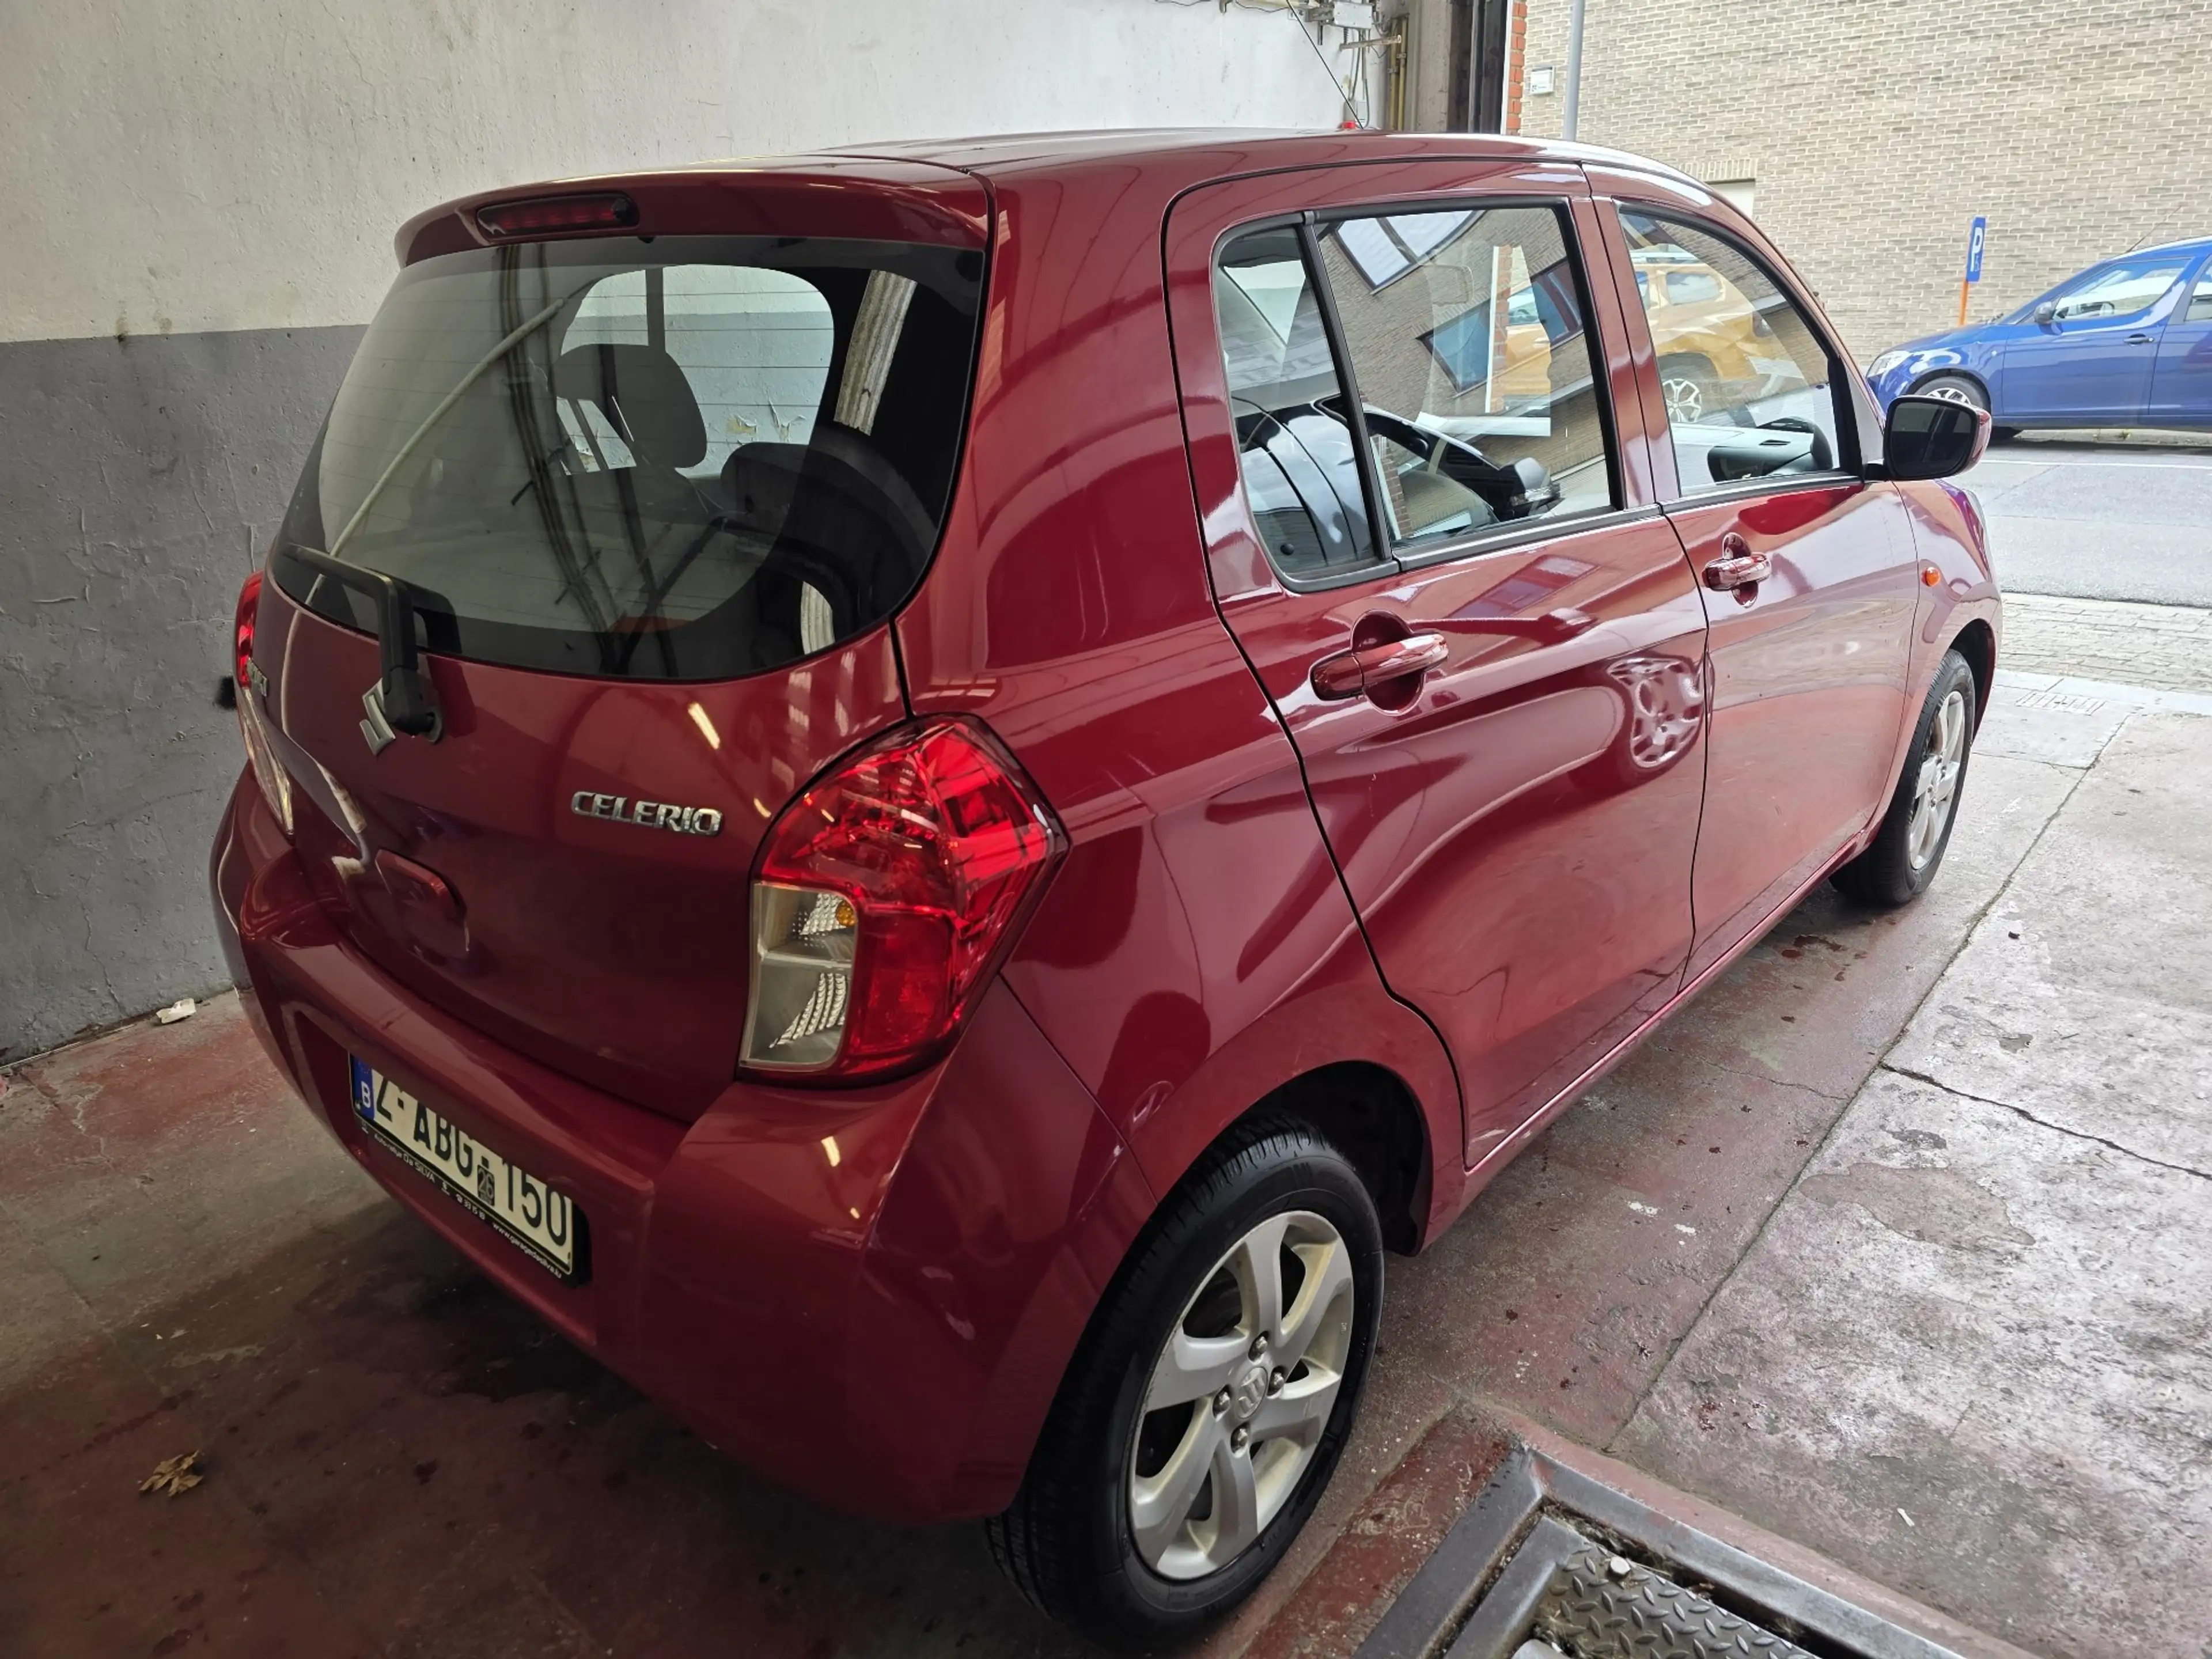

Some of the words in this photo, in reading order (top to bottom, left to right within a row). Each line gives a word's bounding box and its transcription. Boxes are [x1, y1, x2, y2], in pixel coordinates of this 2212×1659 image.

[1970, 227, 1983, 272] P
[571, 791, 723, 835] CELERIO
[361, 1081, 372, 1108] B
[415, 1161, 435, 1183] SILVA
